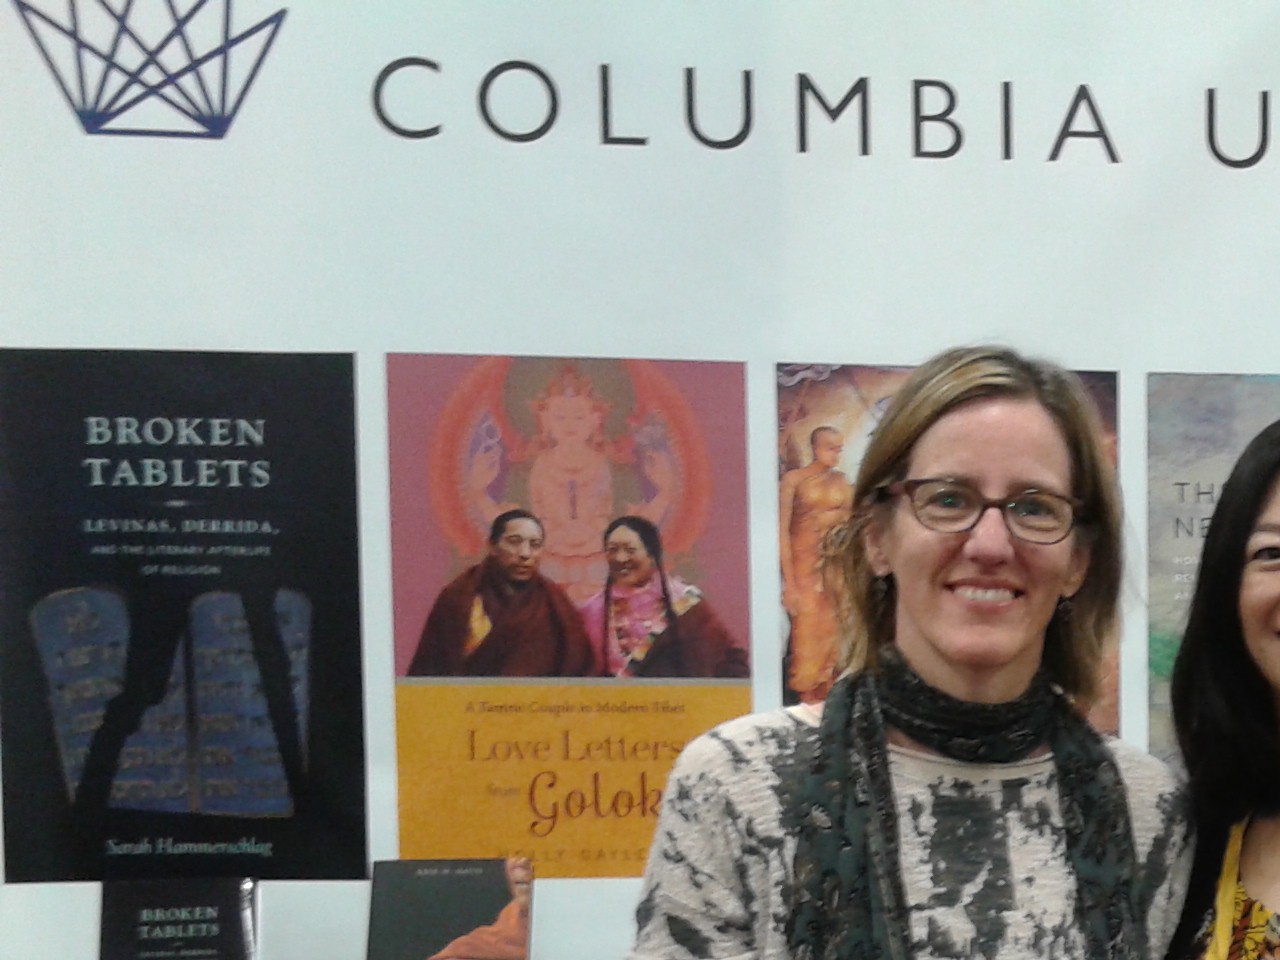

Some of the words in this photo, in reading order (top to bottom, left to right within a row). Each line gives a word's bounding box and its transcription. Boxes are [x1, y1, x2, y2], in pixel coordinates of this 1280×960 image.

[371, 56, 1122, 164] COLUMBIA
[84, 416, 266, 446] BROKEN
[82, 458, 271, 487] TABLETS
[181, 519, 280, 535] DERRIDA,
[528, 701, 580, 717] Couple
[468, 729, 551, 761] Love
[562, 729, 684, 761] Letters
[529, 771, 663, 837] Golok
[140, 907, 219, 921] BROKEN
[137, 923, 220, 938] TABLETS
